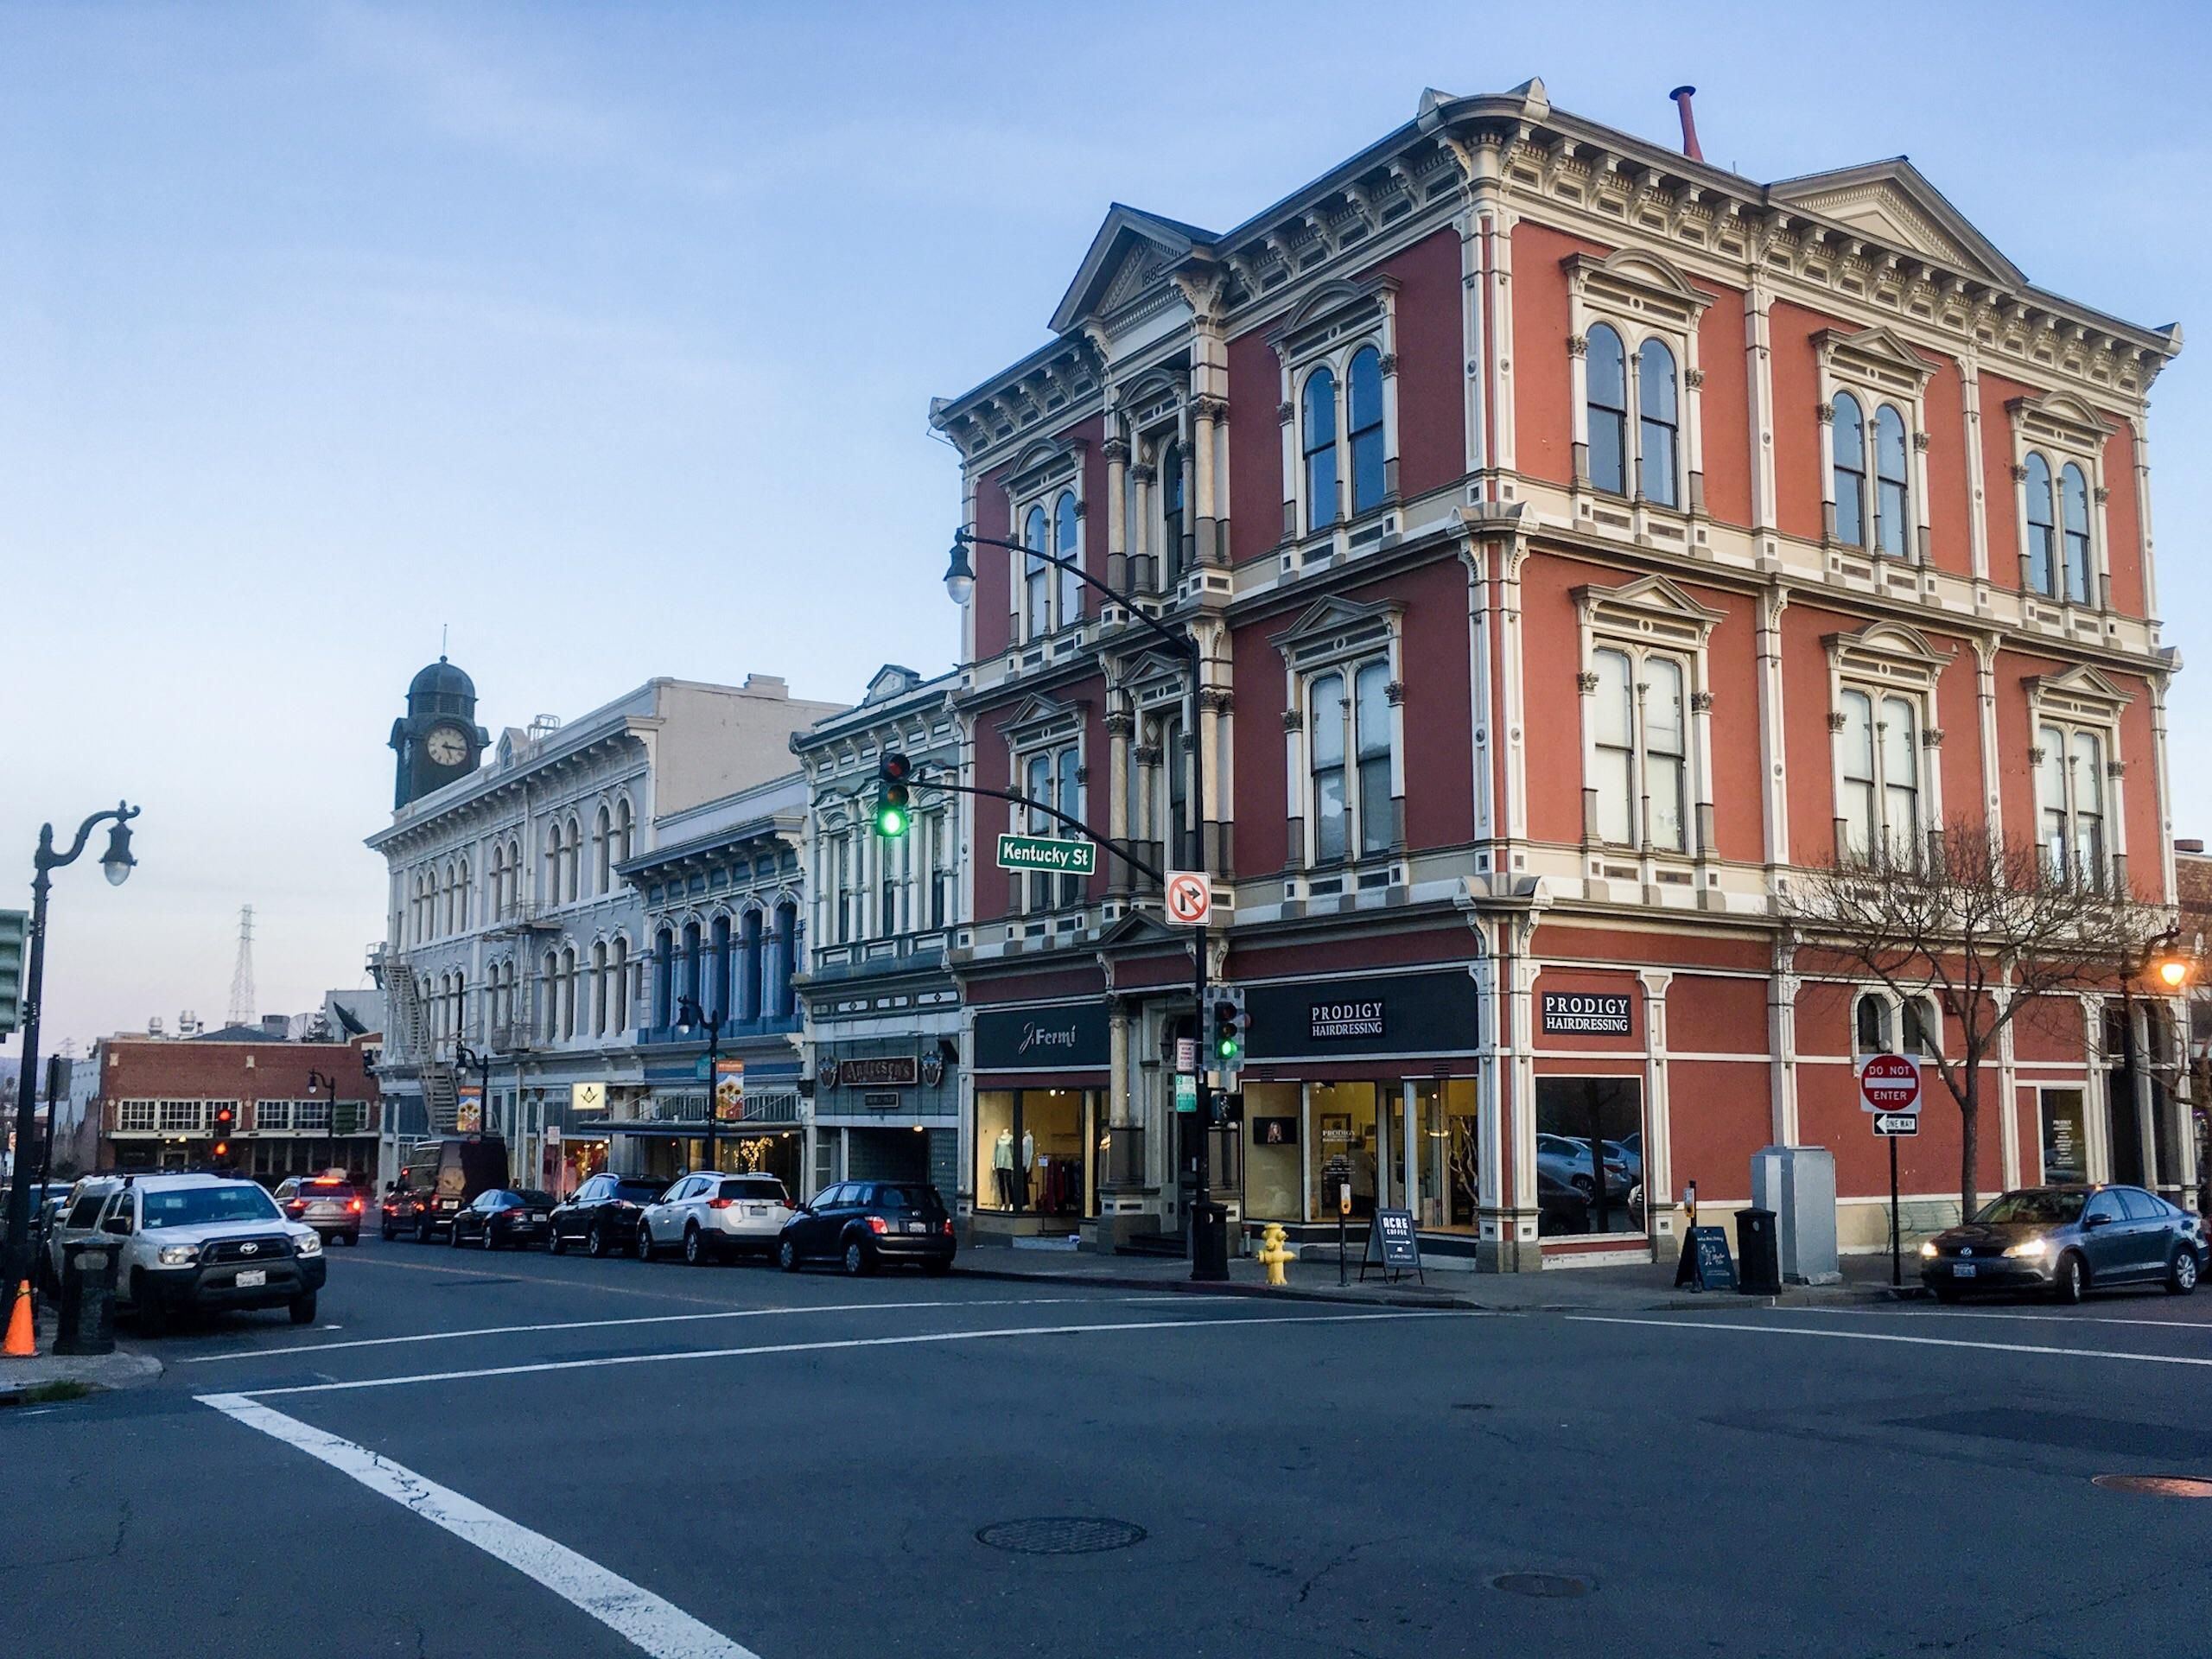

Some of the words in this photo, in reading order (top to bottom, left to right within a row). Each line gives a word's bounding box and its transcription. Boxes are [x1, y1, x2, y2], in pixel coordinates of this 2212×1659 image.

[1003, 842, 1070, 867] Kentucky
[1072, 849, 1089, 866] St
[1312, 1002, 1382, 1020] PRODIGY
[1545, 996, 1628, 1014] PRODIGY
[1313, 1021, 1382, 1037] HAIRDRESSING
[1546, 1017, 1629, 1032] HAIRDRESSING
[1868, 1065, 1884, 1076] DO
[1890, 1065, 1911, 1076] NOT
[1873, 1090, 1908, 1101] ENTER
[1886, 1119, 1899, 1128] ONE
[1900, 1120, 1913, 1128] WAY
[1382, 1217, 1409, 1229] ACRE
